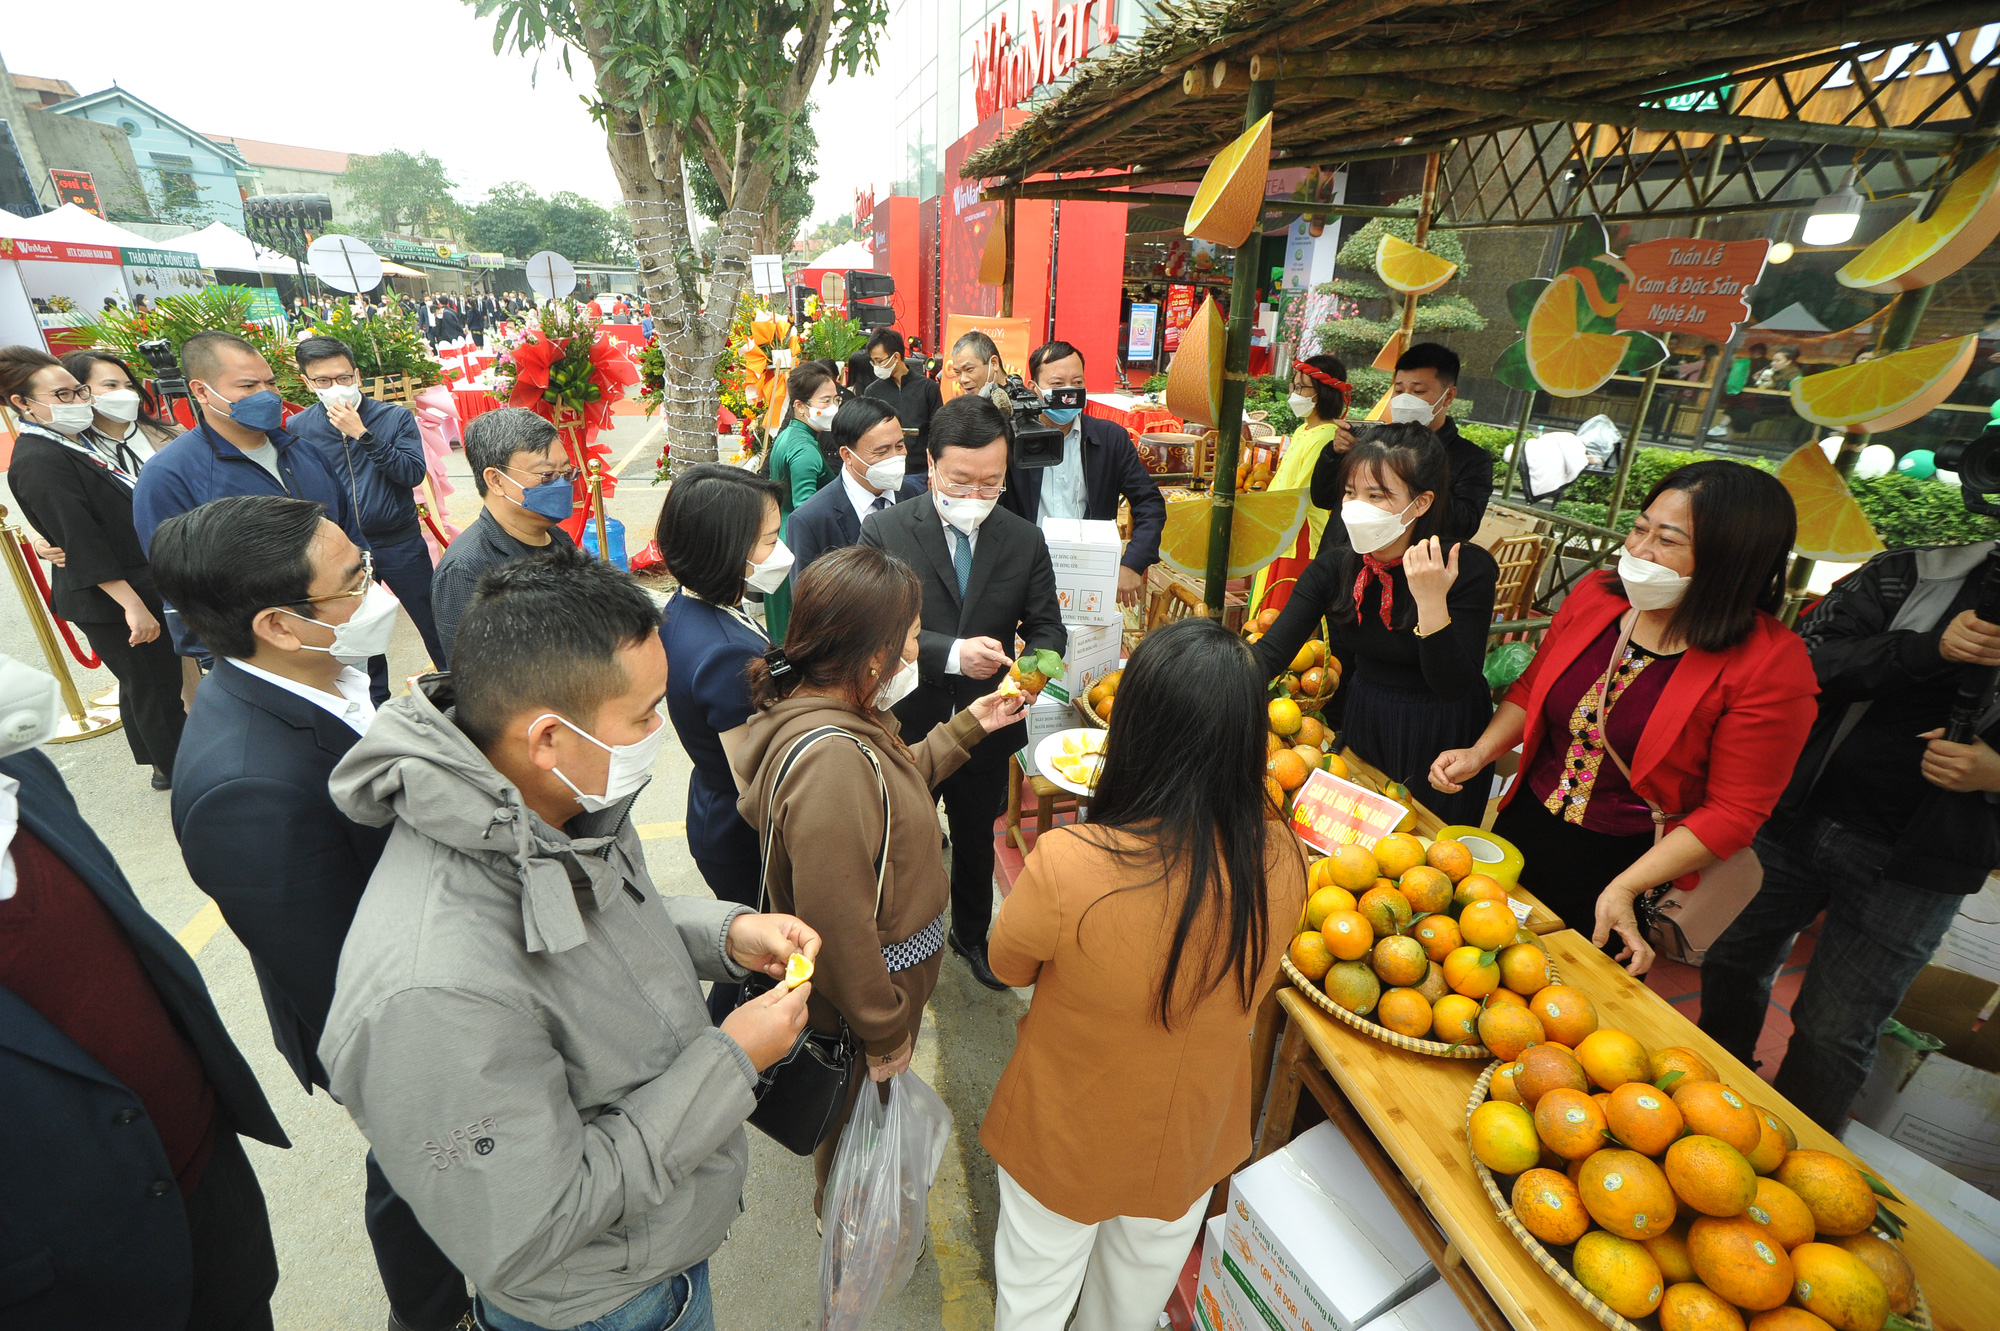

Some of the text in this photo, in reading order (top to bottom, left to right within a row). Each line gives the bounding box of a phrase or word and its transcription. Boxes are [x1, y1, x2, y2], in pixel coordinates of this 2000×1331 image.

[972, 0, 1120, 124] WinMart
[1266, 178, 1285, 194] TEA
[15, 240, 53, 254] WinMart
[128, 249, 197, 268] THẢO MỘC ĐỒNG QUÊ
[1702, 244, 1727, 267] Lễ
[1635, 275, 1741, 299] Cam & Đặc Sản
[1647, 303, 1707, 327] Nghệ An
[1306, 783, 1326, 804] CAM
[1324, 789, 1340, 806] XÃ
[1350, 798, 1373, 822] LÒNG
[1367, 808, 1393, 830] VÀNG
[423, 1116, 499, 1157] SUPER
[431, 1141, 473, 1171] DRY
[1251, 1219, 1272, 1251] Trang
[1284, 1262, 1301, 1285] cam
[1260, 1263, 1272, 1286] CAM
